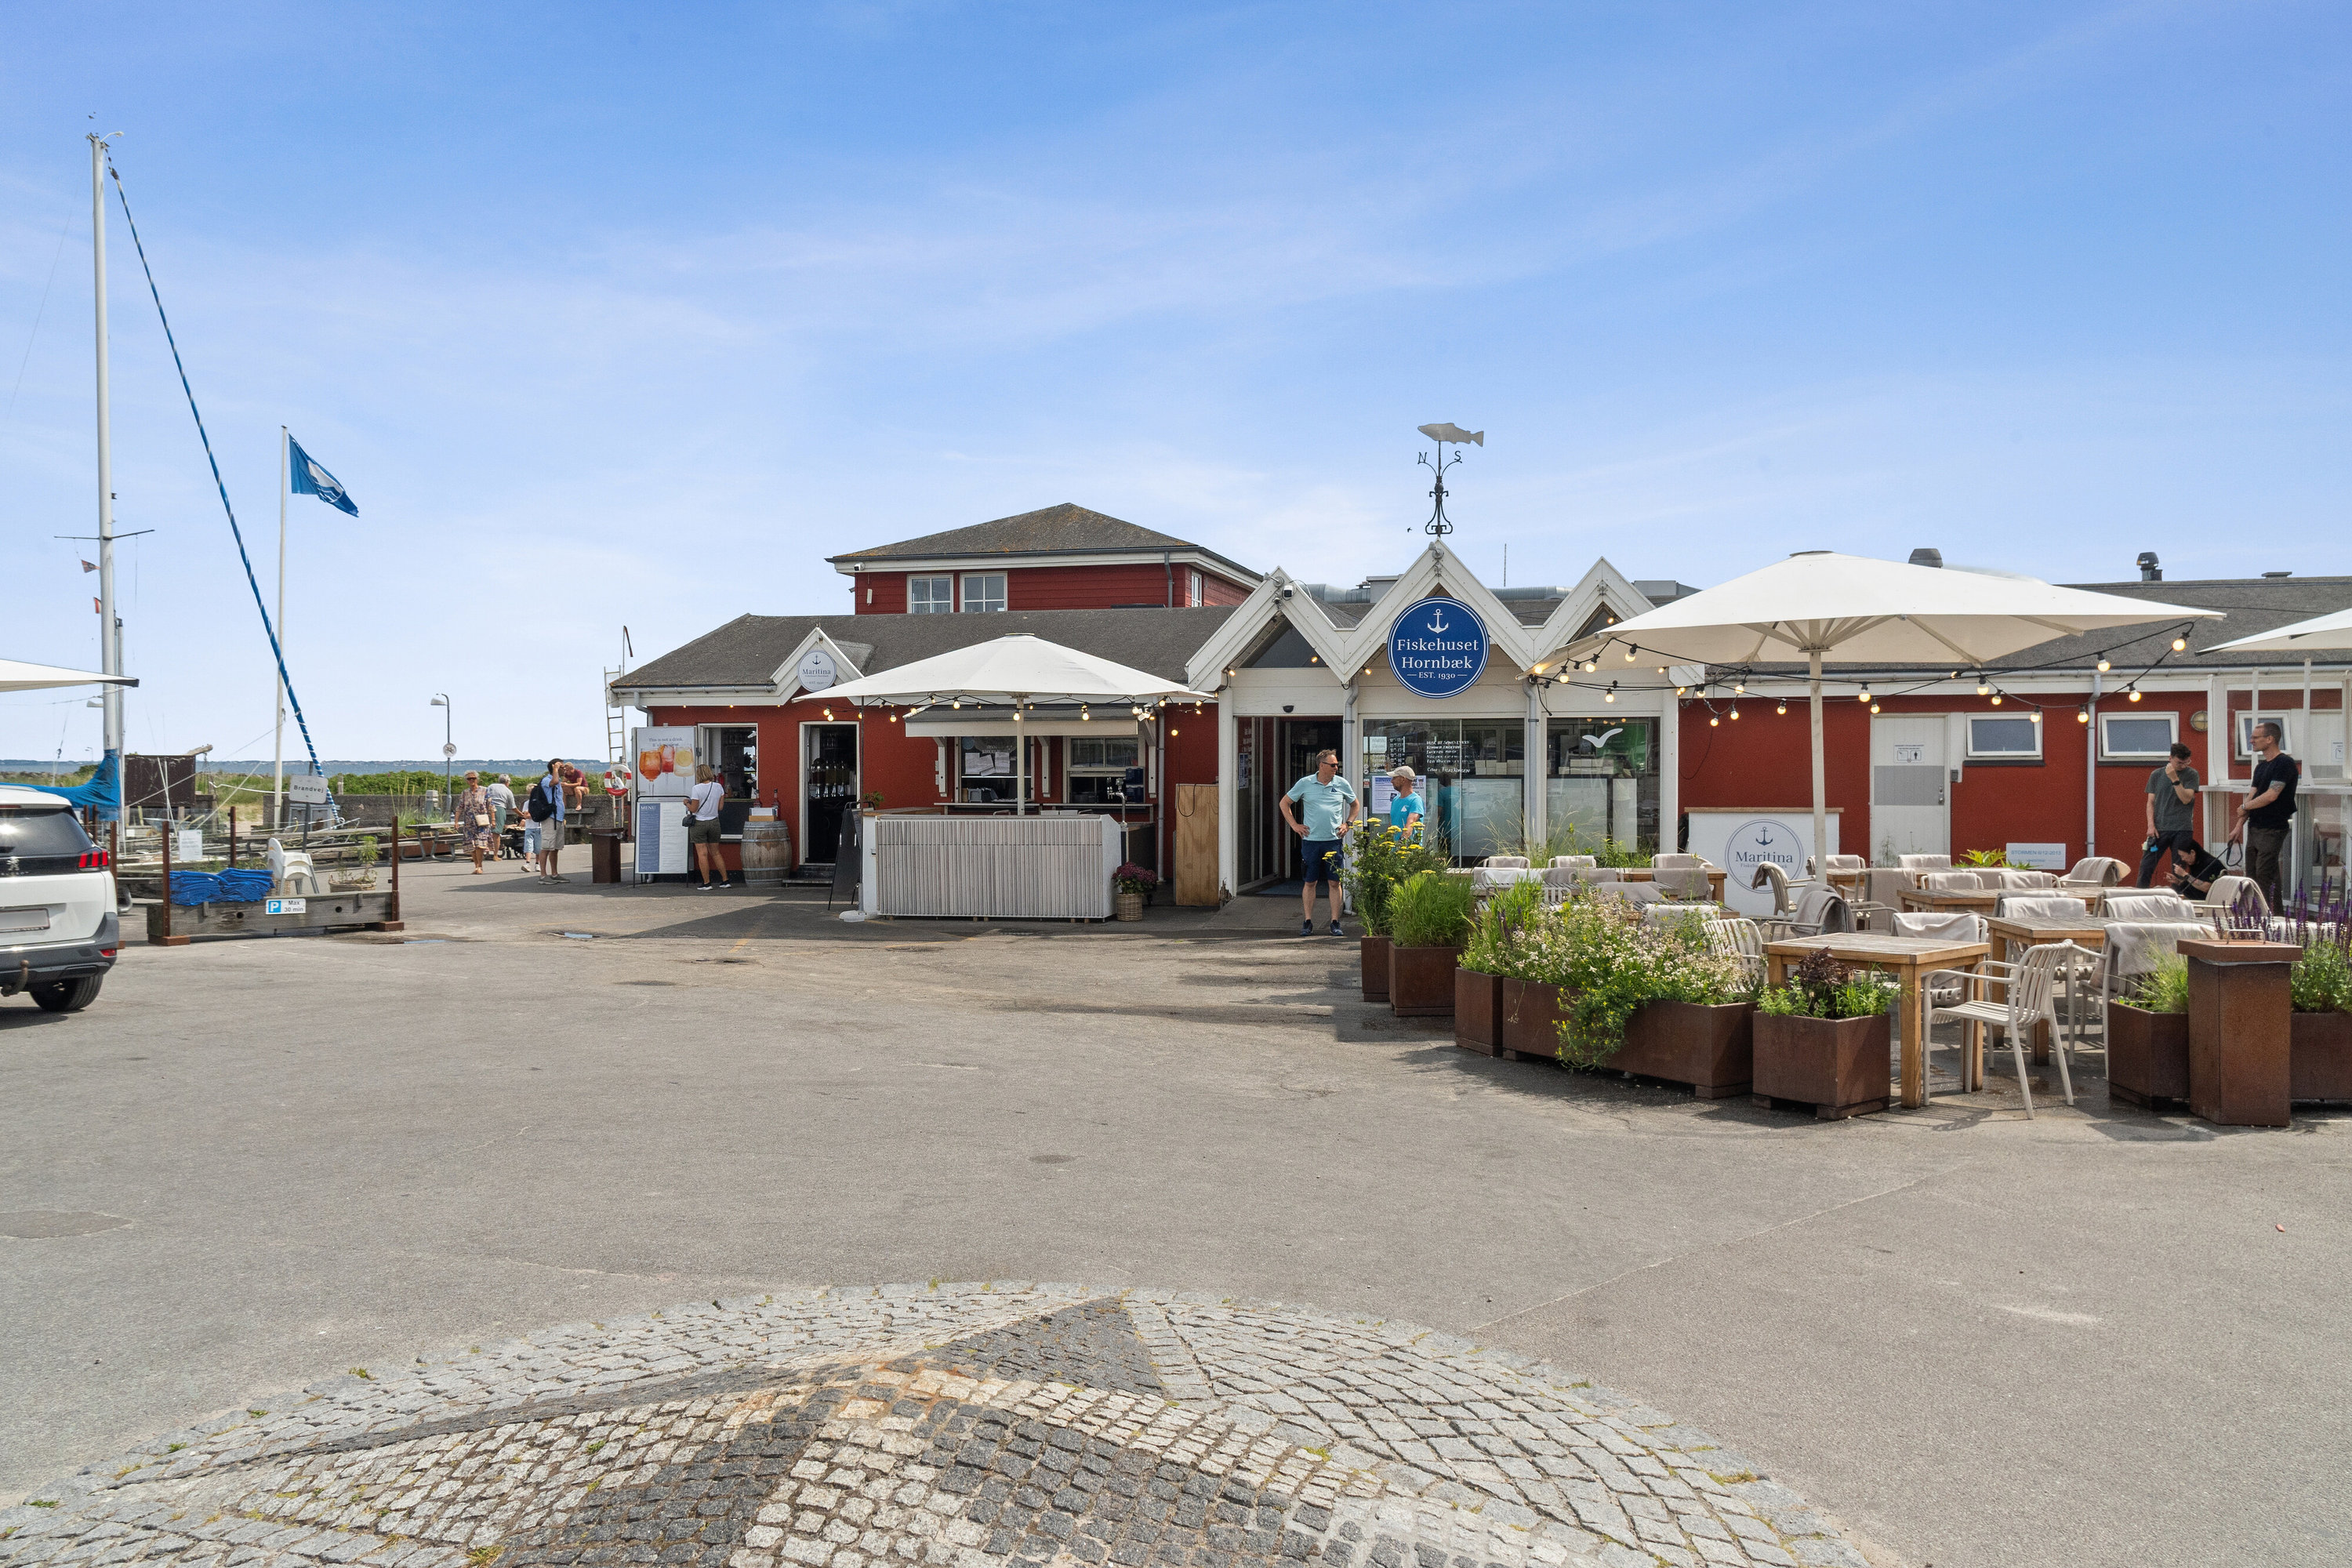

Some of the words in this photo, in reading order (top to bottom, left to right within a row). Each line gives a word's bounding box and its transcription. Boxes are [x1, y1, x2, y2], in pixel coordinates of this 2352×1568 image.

[1417, 452, 1428, 463] N
[1454, 450, 1461, 462] S
[1396, 637, 1479, 652] Fiskehuset
[1401, 655, 1473, 669] Hornbæk
[1735, 851, 1793, 863] Maritina
[270, 902, 279, 913] P
